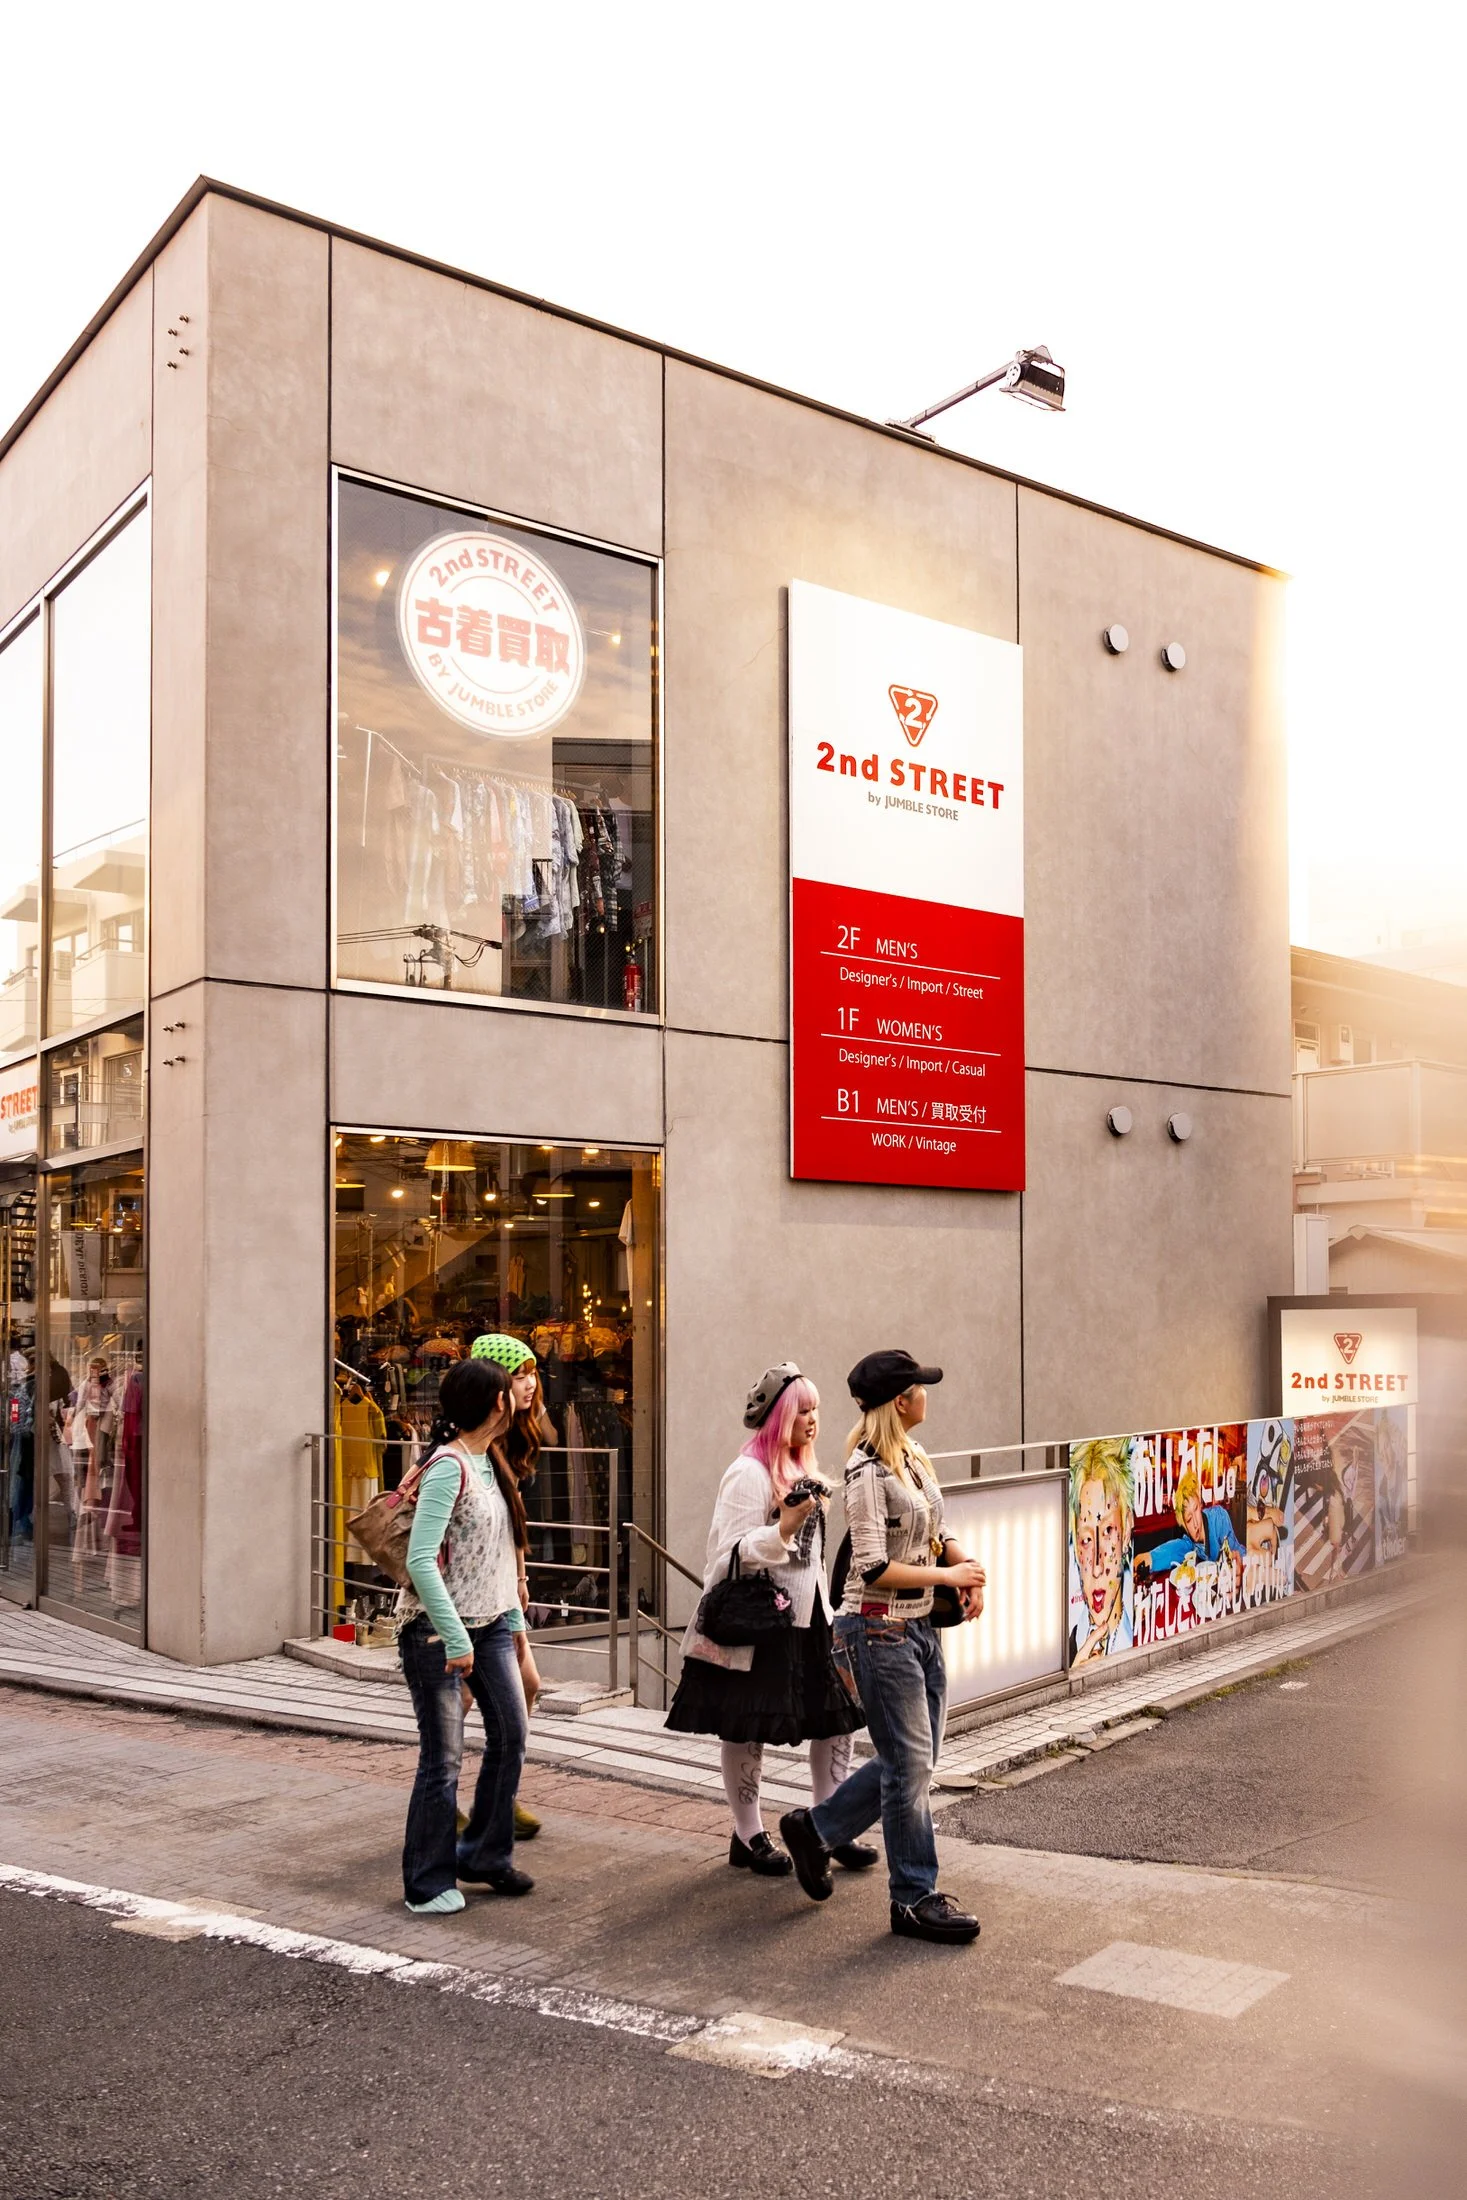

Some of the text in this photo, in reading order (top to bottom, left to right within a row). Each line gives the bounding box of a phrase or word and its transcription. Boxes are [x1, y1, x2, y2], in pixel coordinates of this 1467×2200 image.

[429, 548, 560, 614] 2nd STREET
[415, 597, 570, 677] 古着買取
[428, 652, 559, 719] BY JUMBLE STORE
[816, 741, 1005, 810] 2nd STREET
[867, 791, 959, 821] by JUMBLE STORE
[837, 925, 918, 959] 2F MEN'S
[839, 966, 898, 988] Designer's
[907, 979, 944, 995] Import
[952, 982, 984, 1000] Street
[837, 1006, 943, 1041] 1F WOMEN'S
[839, 1048, 897, 1069] Designer's
[906, 1056, 943, 1074] Import
[952, 1060, 986, 1077] Casual
[0, 1085, 38, 1119] STREET
[837, 1088, 860, 1114] B1
[876, 1097, 919, 1117] MEN'S
[931, 1101, 987, 1125] 買取受付
[871, 1132, 907, 1149] WORK
[915, 1136, 957, 1155] Vintage
[1291, 1372, 1408, 1392] 2nd STREET
[1321, 1395, 1330, 1404] by
